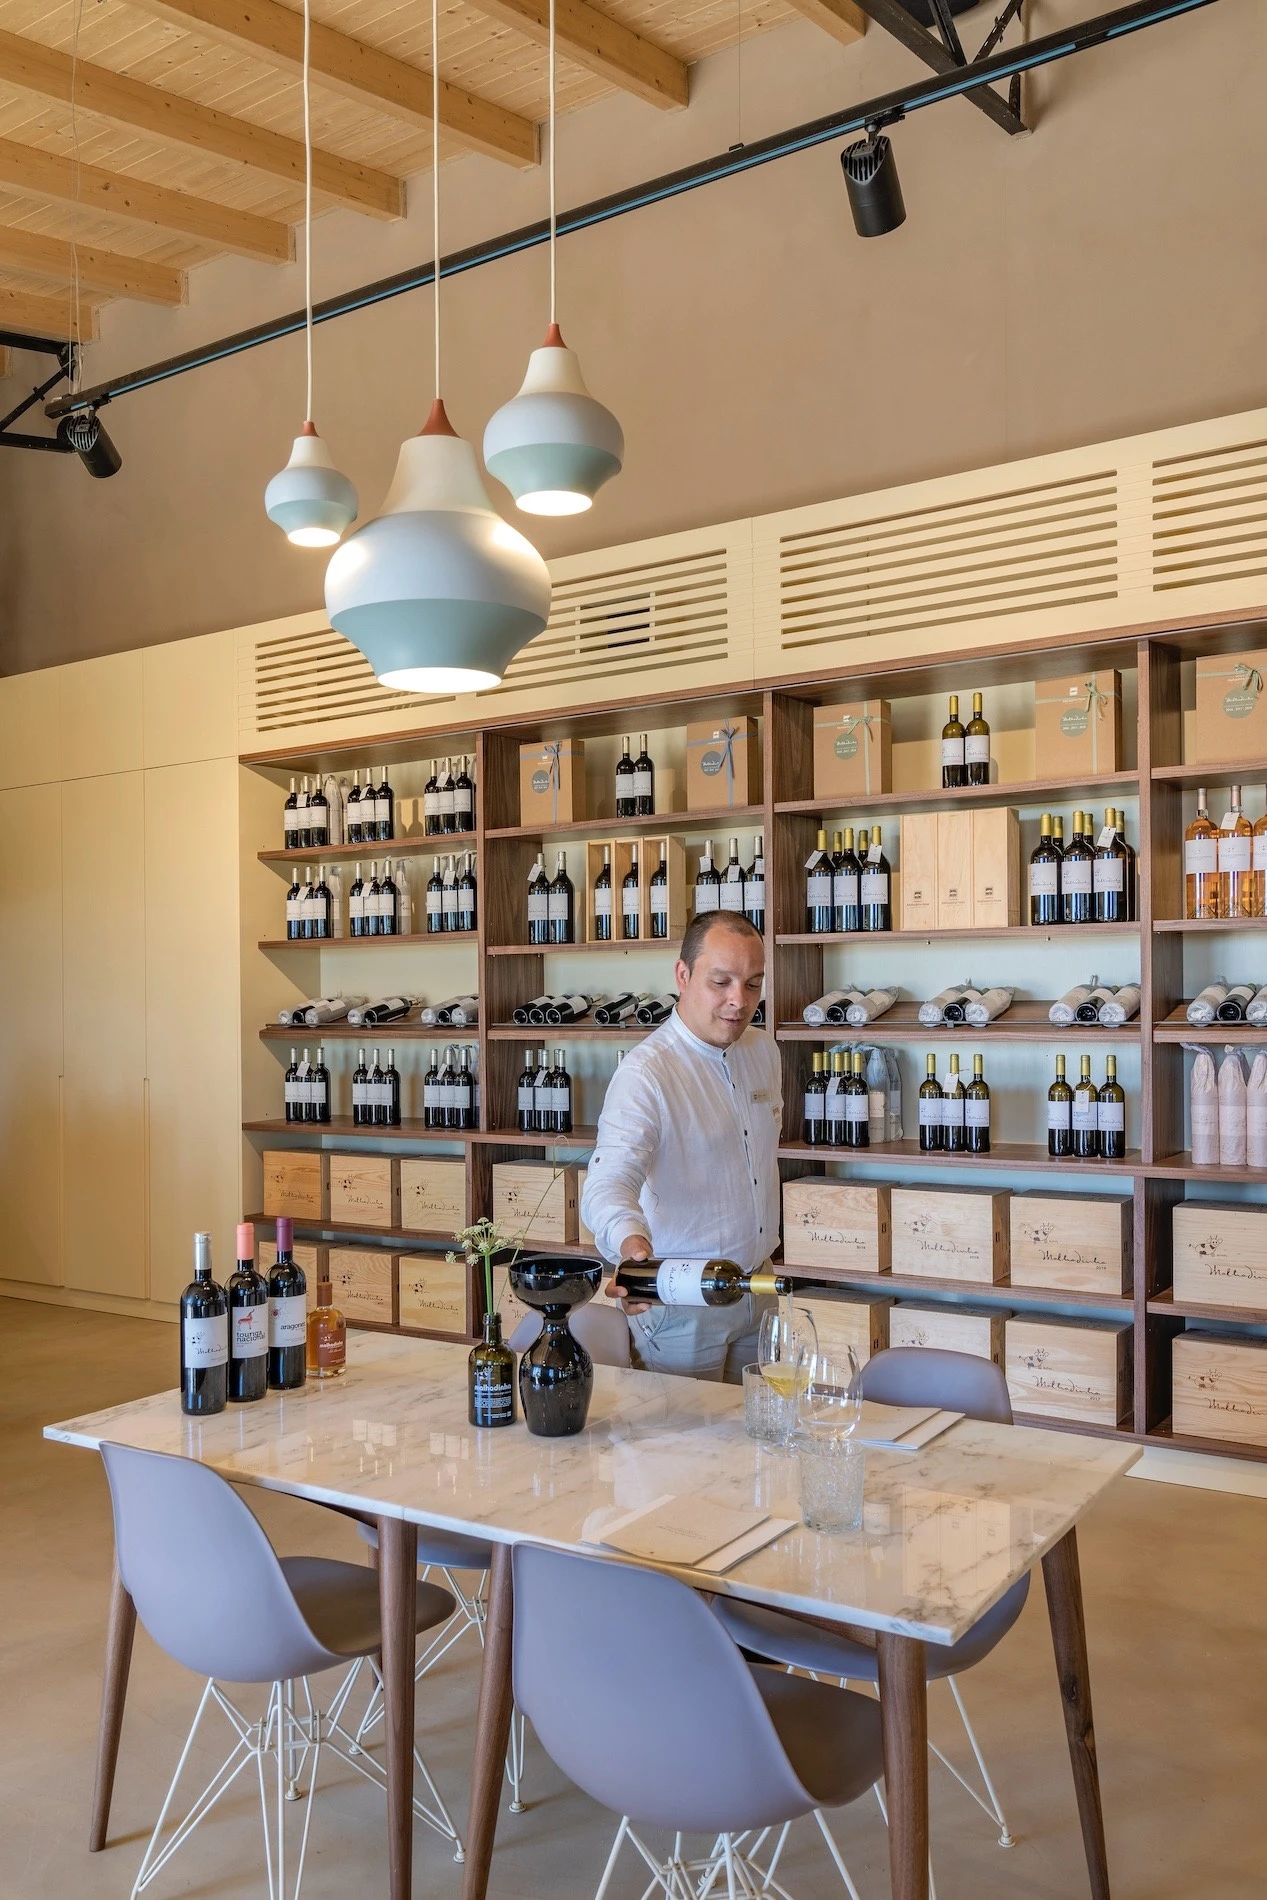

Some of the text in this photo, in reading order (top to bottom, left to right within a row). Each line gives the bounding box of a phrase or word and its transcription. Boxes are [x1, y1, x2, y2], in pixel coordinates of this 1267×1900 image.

[347, 1194, 383, 1205] Malhadinha
[420, 1201, 460, 1211] Malhadinha
[808, 1231, 866, 1244] Malhadinha
[917, 1239, 980, 1254] Malhadinha
[1038, 1250, 1107, 1265] Malhadinha
[417, 1298, 459, 1311] Malhadinha
[236, 1331, 263, 1339] touriga
[236, 1332, 266, 1342] nacional
[474, 1382, 512, 1392] malhadinha
[1032, 1375, 1101, 1395] Malhadinha
